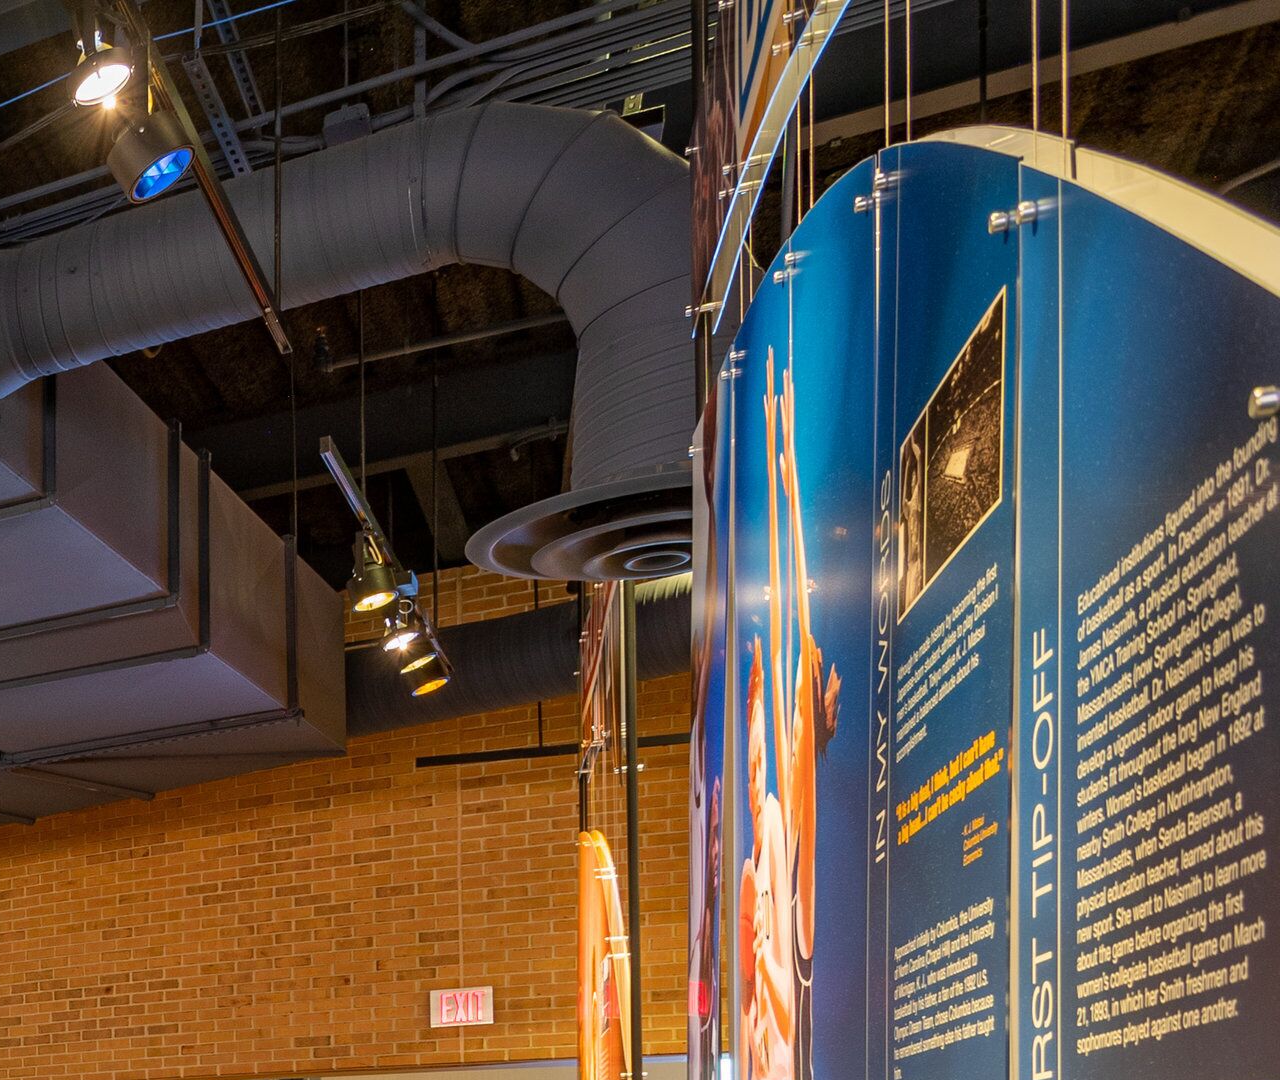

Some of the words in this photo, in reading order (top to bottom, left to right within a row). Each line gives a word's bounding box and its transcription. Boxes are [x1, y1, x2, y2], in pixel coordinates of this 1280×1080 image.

[877, 469, 891, 694] WORDS
[1077, 639, 1101, 670] James
[1102, 609, 1137, 649] Naismith,
[1139, 603, 1145, 620] a
[1146, 567, 1181, 613] physical
[1181, 532, 1226, 584] education
[1227, 497, 1266, 545] teacher
[1266, 482, 1278, 513] at
[1078, 561, 1120, 615] Educational
[1120, 525, 1165, 577] institutions
[1165, 490, 1196, 537] figured
[1196, 477, 1214, 507] into
[1215, 460, 1232, 488] the
[1233, 416, 1278, 472] founding
[1078, 622, 1086, 642] of
[1086, 588, 1124, 636] basketball
[1124, 582, 1135, 603] as
[1136, 575, 1142, 593] a
[1142, 551, 1166, 588] sport.
[1168, 542, 1177, 564] In
[1178, 499, 1225, 556] December
[1255, 457, 1270, 486] Dr.
[1077, 677, 1089, 697] the
[1090, 653, 1115, 687] YMCA
[1114, 632, 1146, 668] Training
[1147, 602, 1176, 644] School
[1177, 598, 1186, 620] in
[875, 809, 886, 864] IN
[876, 709, 887, 793] MY
[1032, 627, 1055, 918] TIP-OFF
[440, 991, 485, 1024] EXIT
